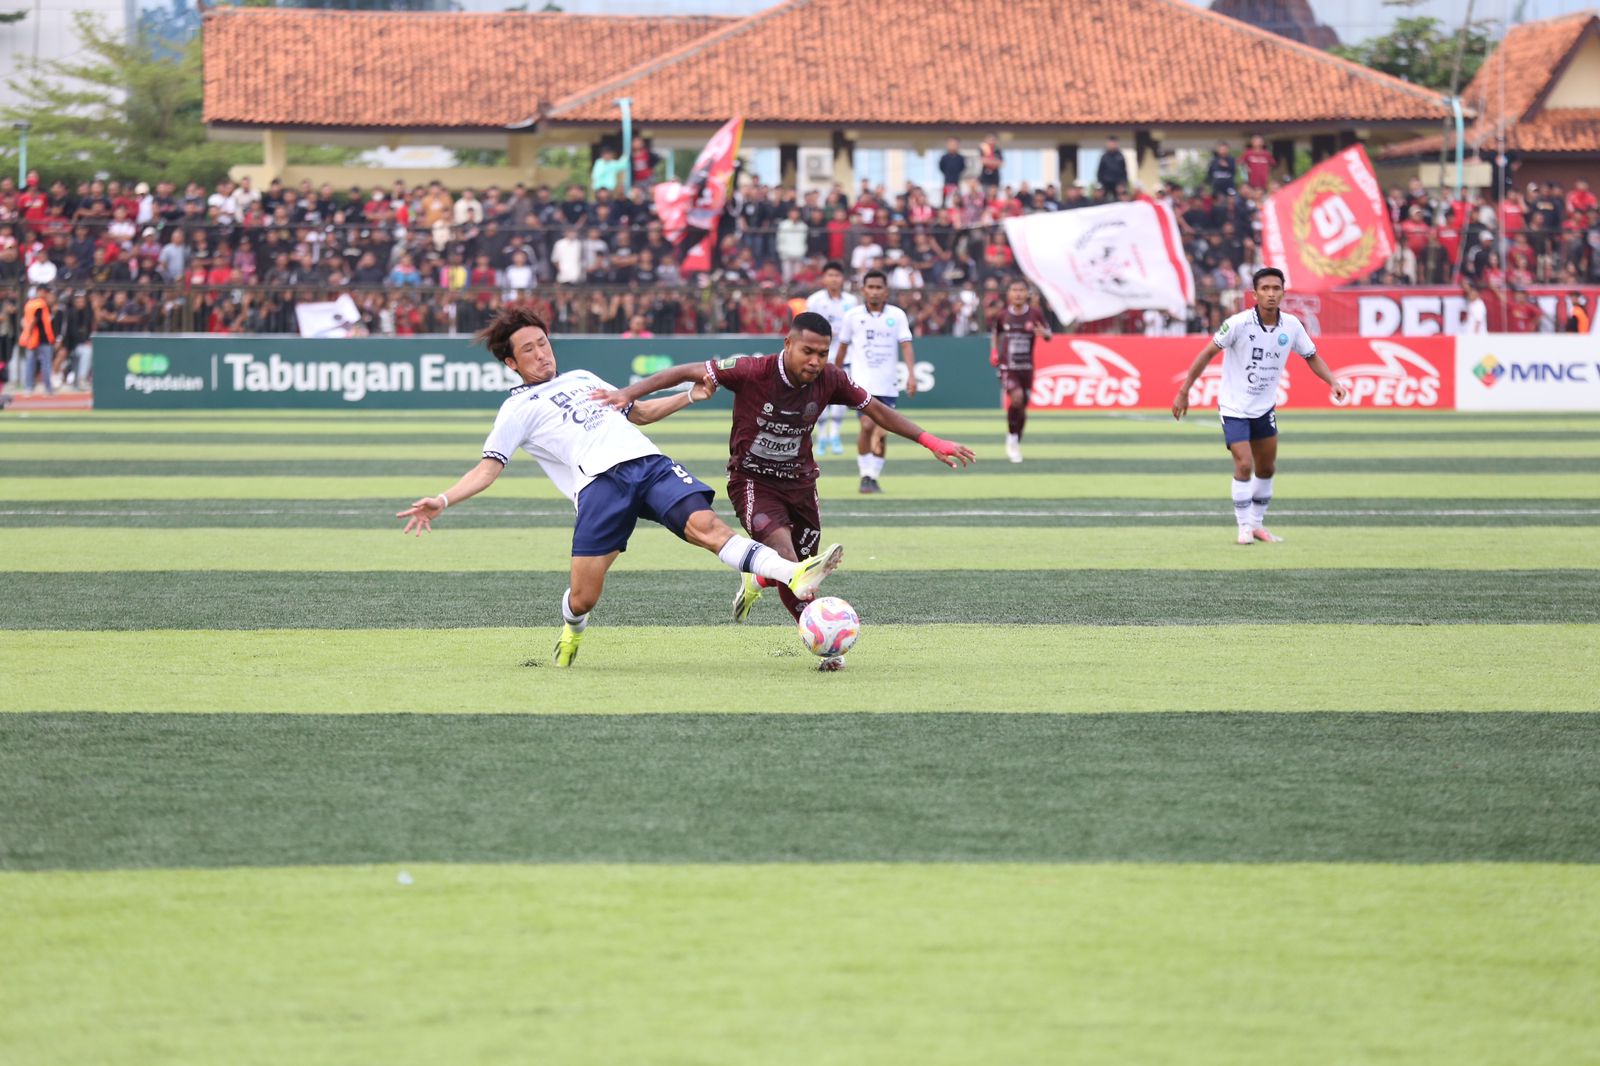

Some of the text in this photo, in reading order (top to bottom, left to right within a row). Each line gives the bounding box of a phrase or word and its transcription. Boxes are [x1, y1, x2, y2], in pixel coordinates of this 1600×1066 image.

[124, 374, 204, 394] Pegadaian
[223, 353, 414, 401] Tabungan
[1511, 363, 1587, 382] MNC
[1030, 377, 1141, 406] SPECS
